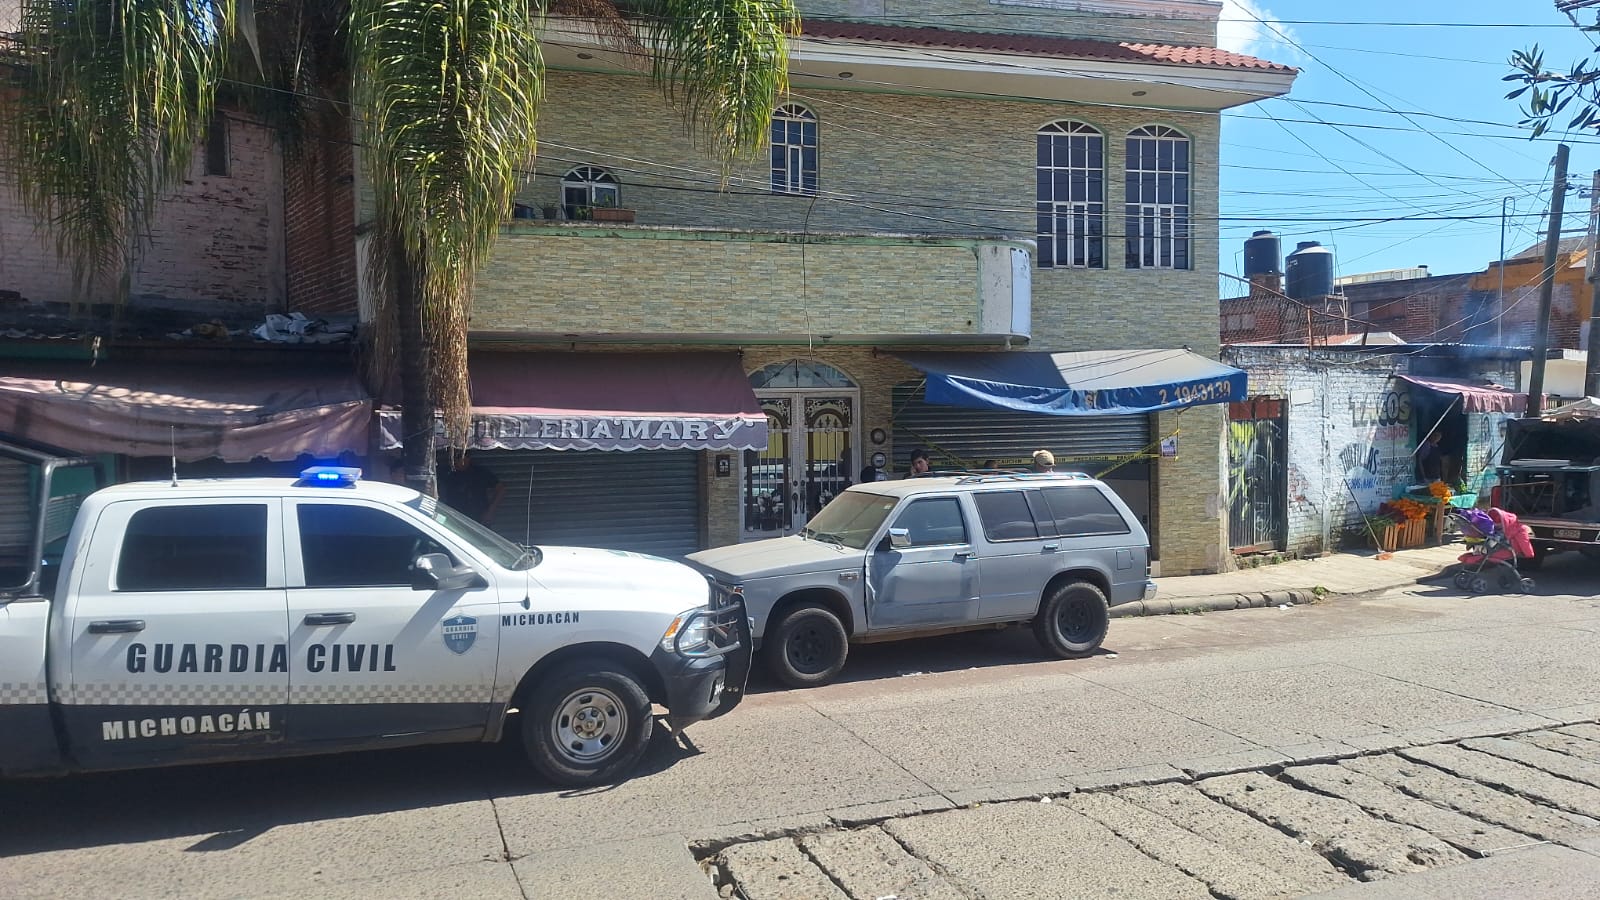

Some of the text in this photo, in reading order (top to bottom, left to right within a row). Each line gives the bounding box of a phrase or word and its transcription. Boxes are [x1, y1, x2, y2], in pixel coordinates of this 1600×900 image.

[1349, 391, 1411, 427] TACOS
[126, 643, 397, 673] GUARDIA CIVIL
[102, 708, 271, 741] MICHOACÁN
